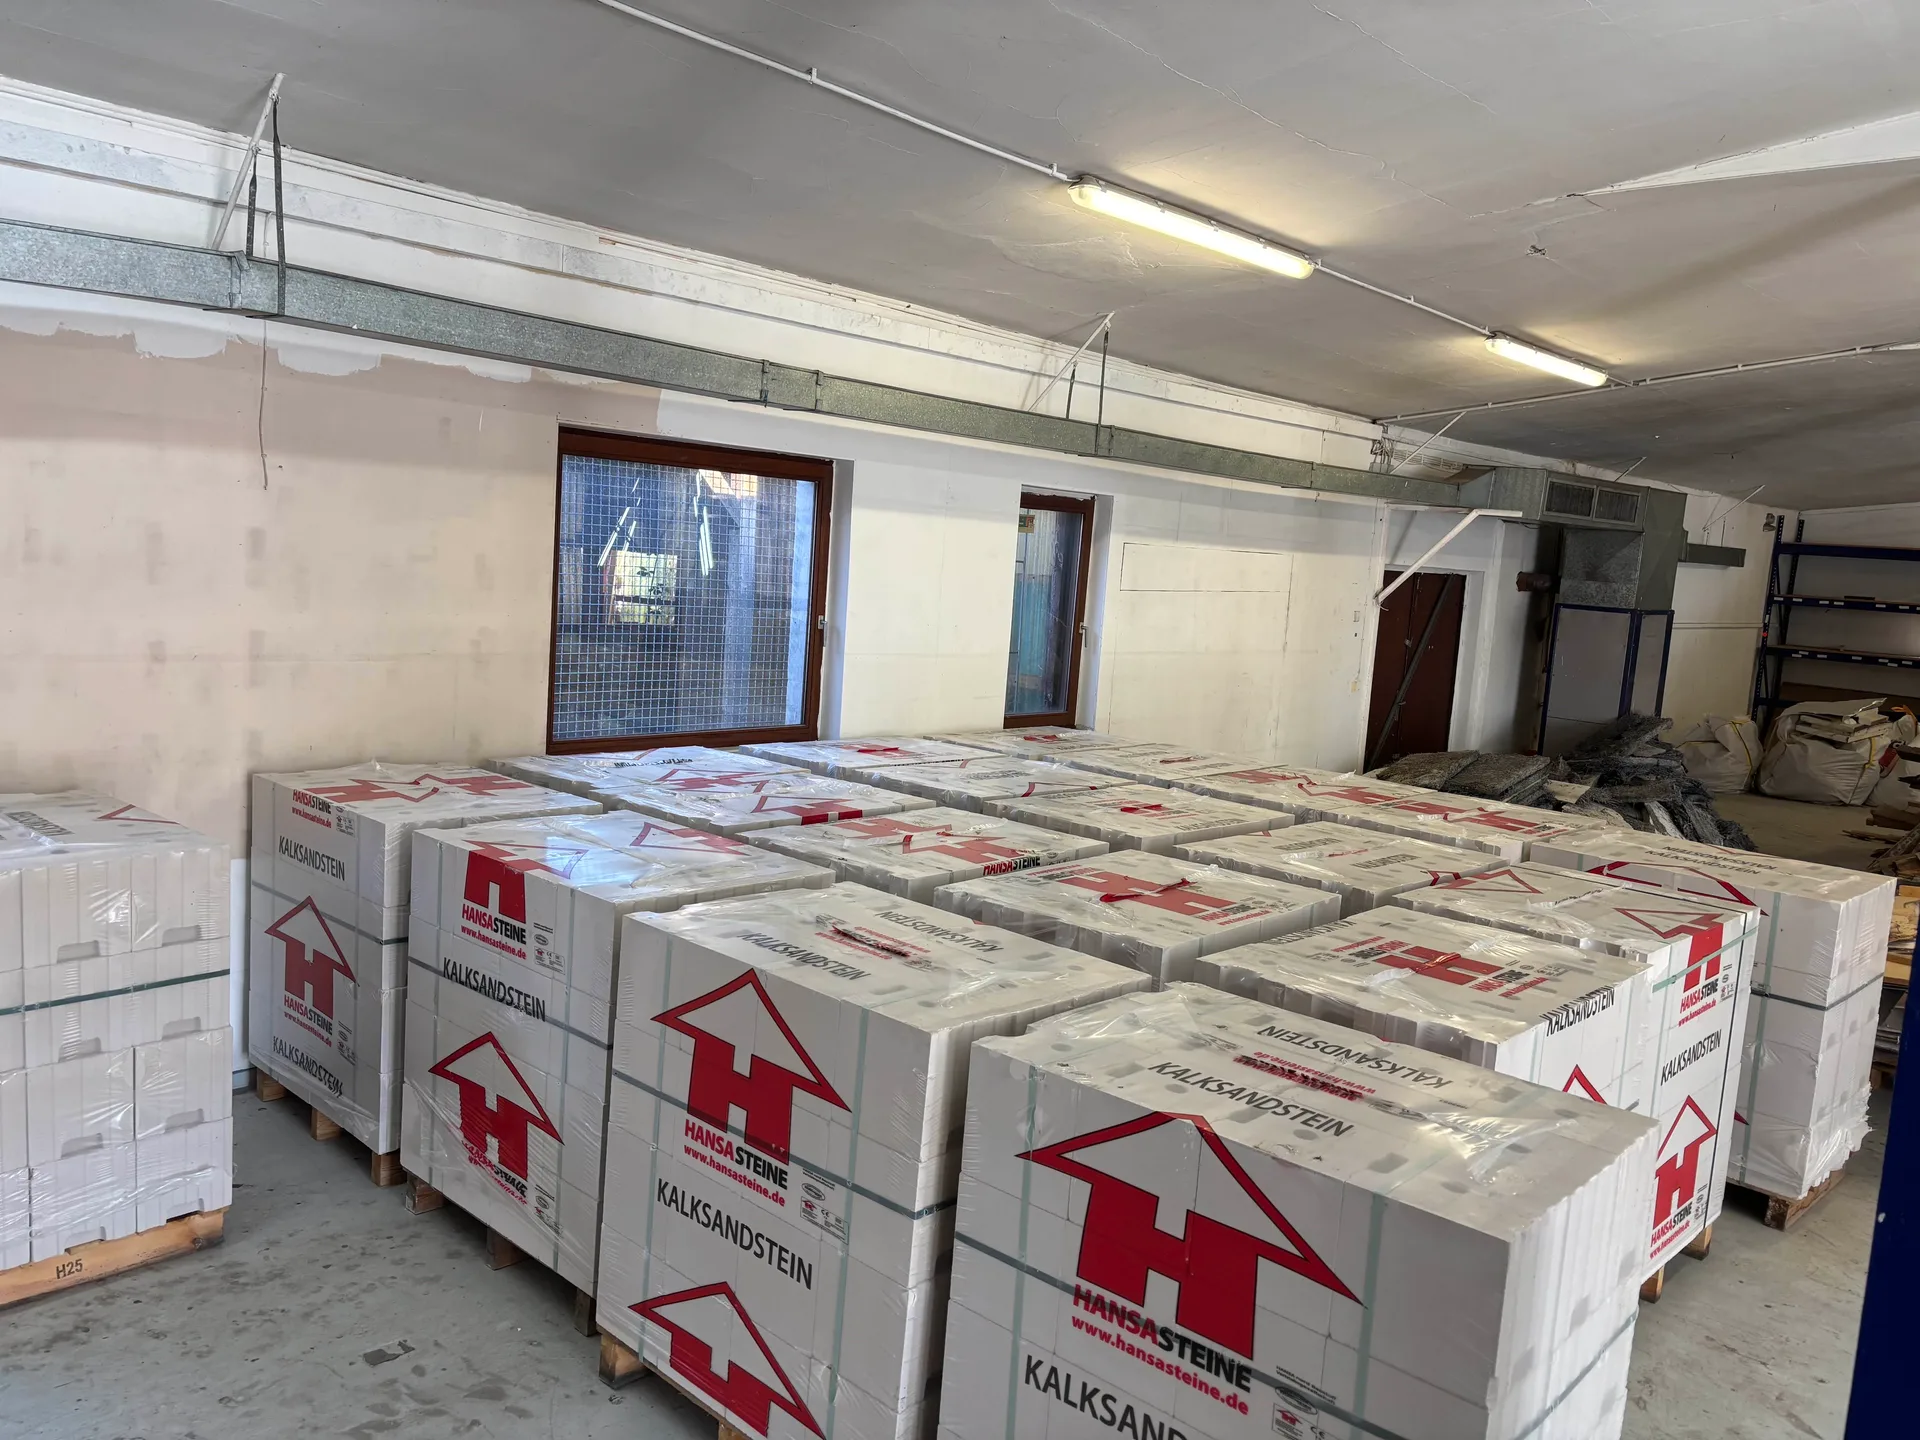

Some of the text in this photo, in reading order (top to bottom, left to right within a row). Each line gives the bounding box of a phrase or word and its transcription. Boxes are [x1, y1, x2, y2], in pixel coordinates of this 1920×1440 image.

[292, 789, 332, 814] HANSASTEINE
[278, 834, 346, 882] KALKSANDSTEIN
[1645, 850, 1761, 875] KALKSANDSTEIN
[460, 924, 528, 960] www.hansasteine.de
[462, 903, 527, 945] HANSASTEINE
[874, 909, 1005, 954] KALKSANDSTEIN
[736, 930, 872, 981] KALKSANDSTEIN
[284, 994, 334, 1036] HANSASTEINE
[442, 956, 547, 1023] KALKSANDSTEIN
[1257, 1025, 1454, 1090] KALKSANDSTEIN
[1660, 1028, 1722, 1087] KALKSANDSTEIN
[1148, 1061, 1355, 1138] KALKSANDSTEIN
[683, 1118, 789, 1191] HANSASTEINE
[683, 1144, 787, 1208] www.hansasteine.de
[657, 1177, 813, 1291] KALKSANDSTEIN
[56, 1258, 84, 1280] H25
[1071, 1314, 1249, 1416] www.hansasteine.de
[1072, 1283, 1252, 1394] HANSASTEINE
